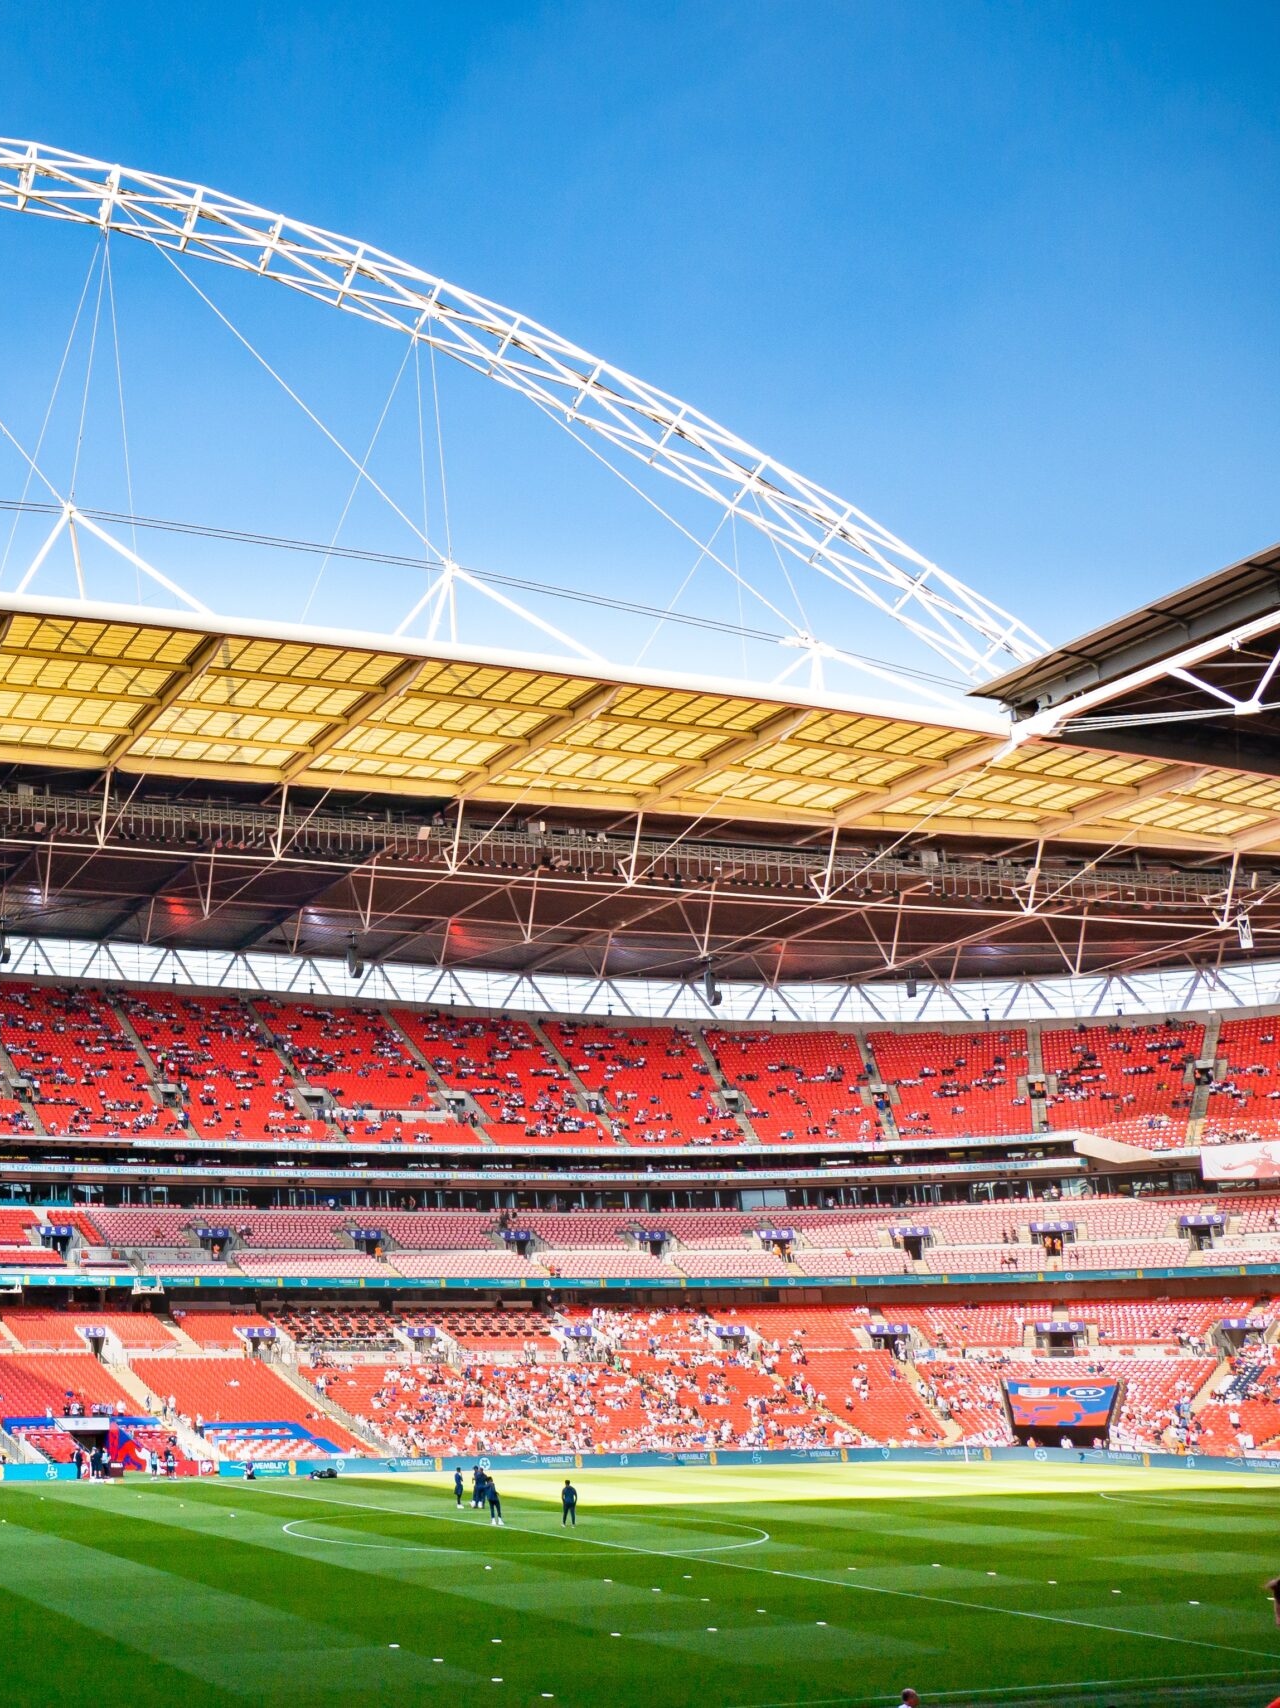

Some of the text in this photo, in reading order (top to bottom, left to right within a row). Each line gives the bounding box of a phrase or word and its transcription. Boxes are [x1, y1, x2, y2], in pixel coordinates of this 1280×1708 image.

[21, 1164, 60, 1172] CONNECTED
[541, 1455, 573, 1463] WEMBLEY
[1107, 1452, 1141, 1460] WEMBLEY
